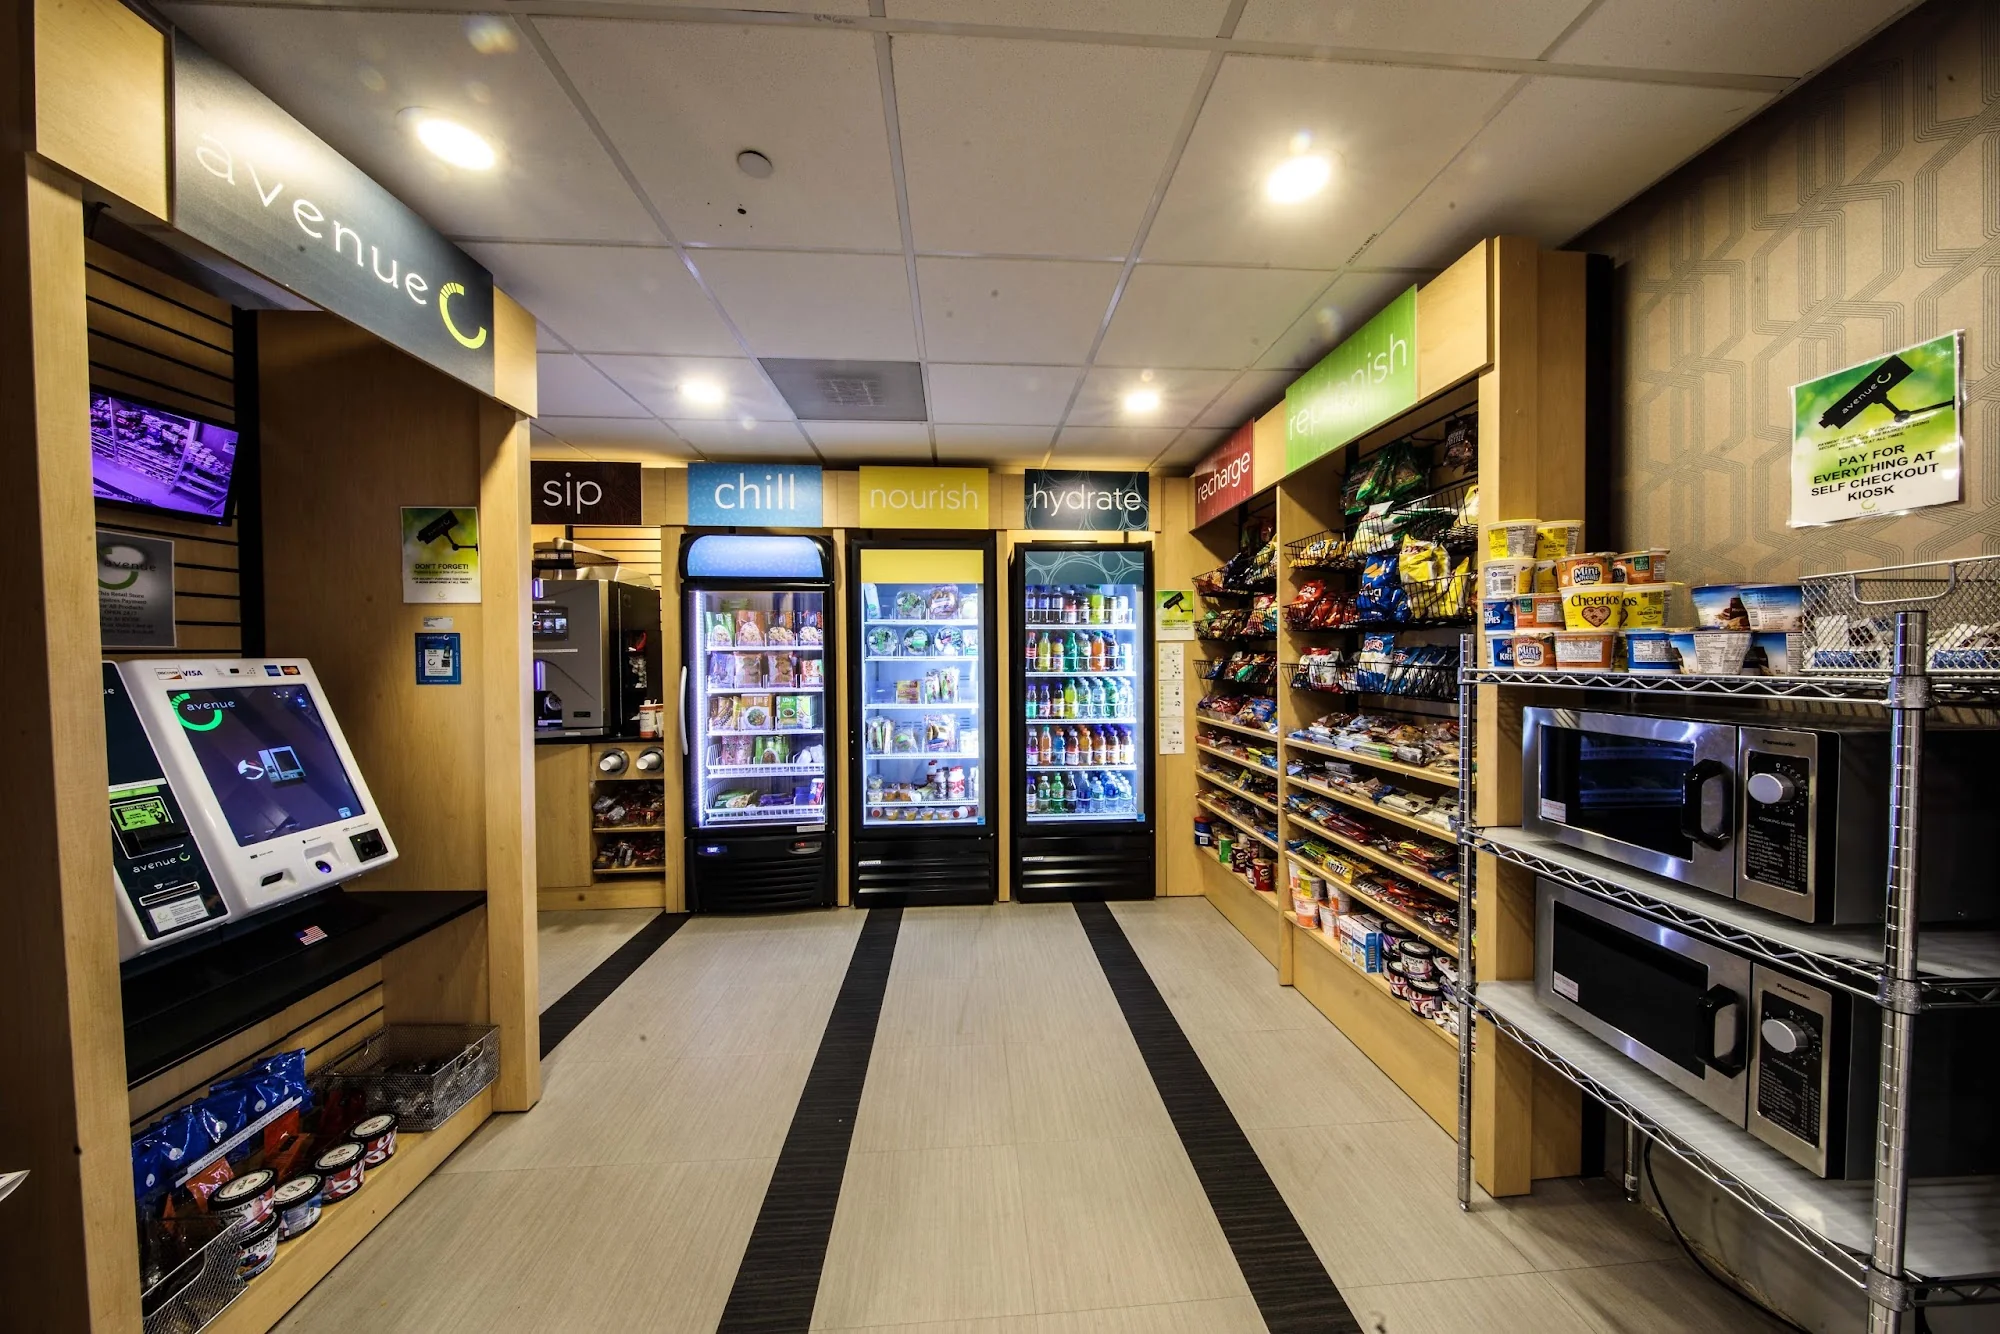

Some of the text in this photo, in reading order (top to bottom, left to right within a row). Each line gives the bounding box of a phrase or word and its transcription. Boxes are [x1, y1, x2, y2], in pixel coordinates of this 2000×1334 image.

[196, 132, 430, 306] avenue
[1289, 332, 1407, 441] repenish
[1841, 383, 1878, 415] avenue
[1839, 444, 1906, 468] PAY FOR
[1814, 450, 1936, 484] EVERYTHING AT
[1197, 450, 1251, 504] recharge
[1811, 463, 1940, 497] SELF CHECKOUT
[542, 472, 602, 514] sip
[714, 472, 795, 510] chill
[870, 483, 979, 510] nourish
[1032, 483, 1142, 516] hydrate
[1848, 485, 1894, 502] KIOSK
[104, 560, 156, 572] avenue
[1574, 566, 1598, 576] Mini
[1574, 574, 1600, 584] Wheats
[1571, 592, 1620, 606] Cheerios
[1518, 646, 1539, 654] Mini
[1518, 654, 1541, 662] Wheats
[186, 700, 236, 711] avenue
[1762, 739, 1796, 748] Panasonic
[1758, 816, 1780, 824] COOKING
[132, 856, 176, 873] avenue
[1776, 983, 1810, 1000] Panasonic
